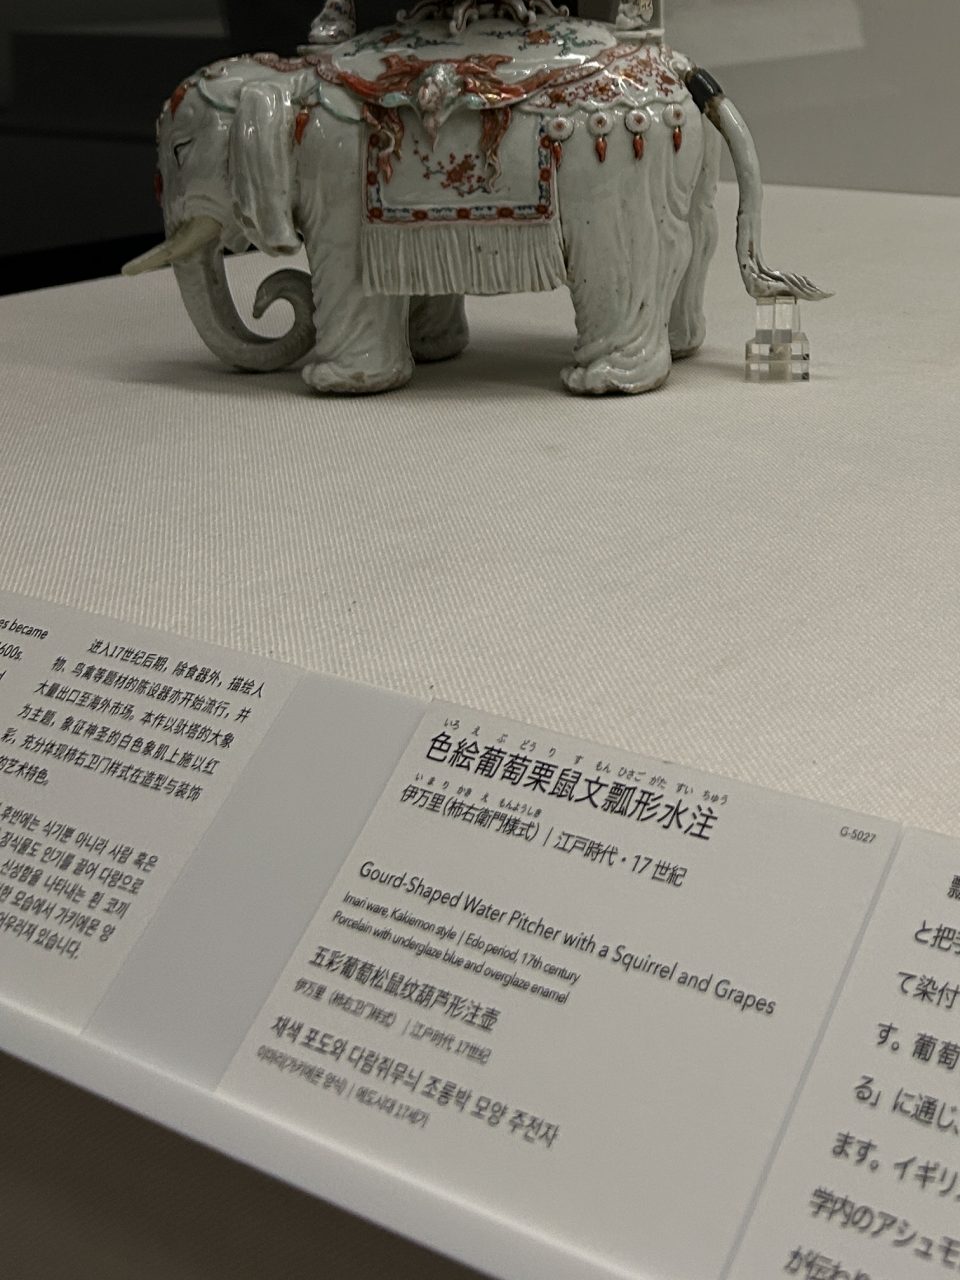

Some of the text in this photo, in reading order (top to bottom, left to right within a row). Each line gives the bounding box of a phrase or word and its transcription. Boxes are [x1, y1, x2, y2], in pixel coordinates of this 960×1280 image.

[0, 641, 23, 661] 600s.
[9, 618, 49, 640] became
[471, 725, 481, 737] え
[400, 783, 541, 842] 伊万里(柿右衛門様式)
[425, 730, 719, 842] 色絵葡萄栗鼠文瓢形水注
[74, 831, 110, 856] 아니라
[109, 843, 135, 865] 사람
[133, 851, 159, 872] 혹은
[840, 825, 877, 845] G-5027
[332, 909, 571, 1005] Porcelain with underglaze blue and overglaze enamel
[343, 890, 368, 910] Imari
[365, 900, 390, 919] ware,
[389, 906, 437, 934] Kakiemon
[435, 922, 458, 941] style
[464, 932, 486, 951] Edo
[483, 941, 518, 966] period,
[520, 951, 543, 970] 17th
[542, 962, 582, 986] century
[358, 860, 778, 1017] Gourd-Shaped Water Pitcher with a Squirrel and Grapes
[308, 945, 502, 1032] 五彩葡萄松鼠纹葫芦形注壶
[298, 1026, 349, 1062] 포도와
[469, 1095, 509, 1128] 모양
[508, 1108, 560, 1149] 주전자
